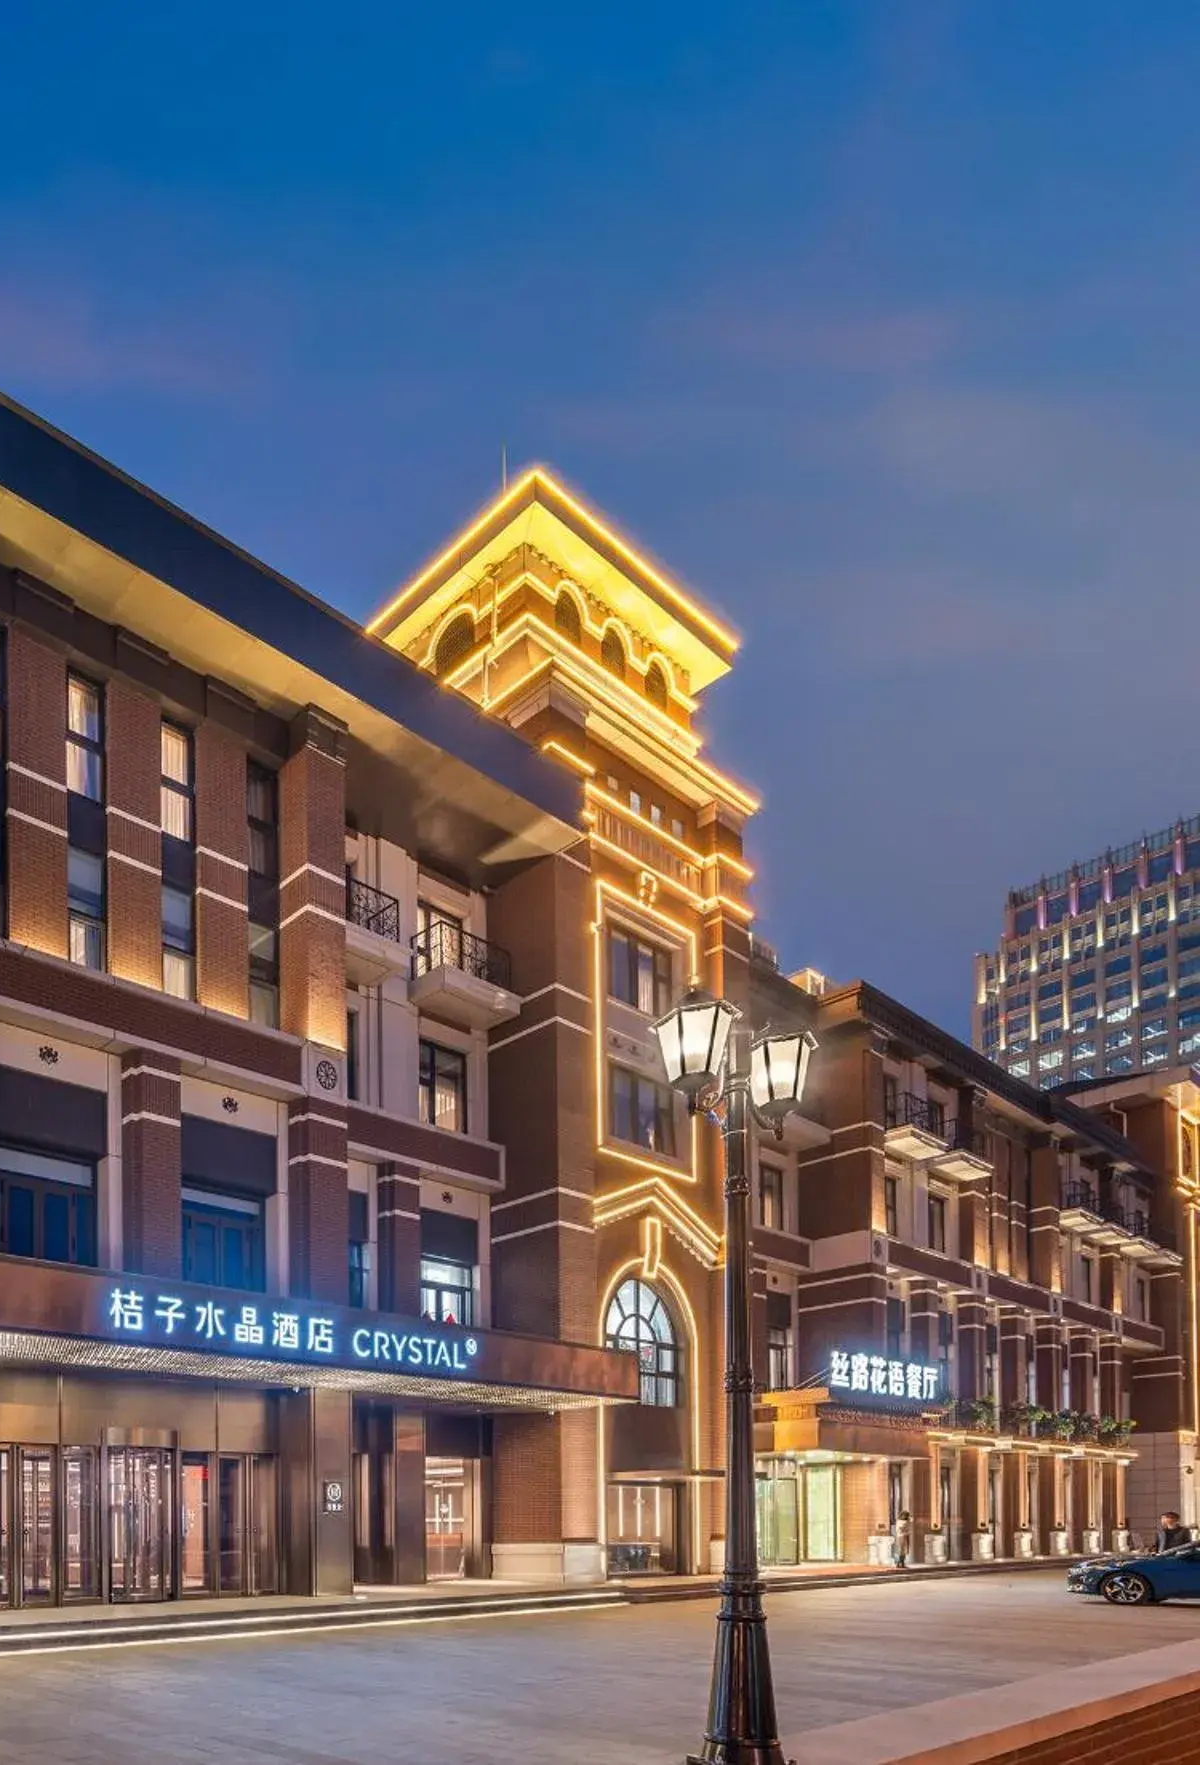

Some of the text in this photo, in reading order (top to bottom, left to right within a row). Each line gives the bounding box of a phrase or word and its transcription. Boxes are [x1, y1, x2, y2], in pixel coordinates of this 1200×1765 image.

[109, 1288, 334, 1354] 桔子水晶酒店
